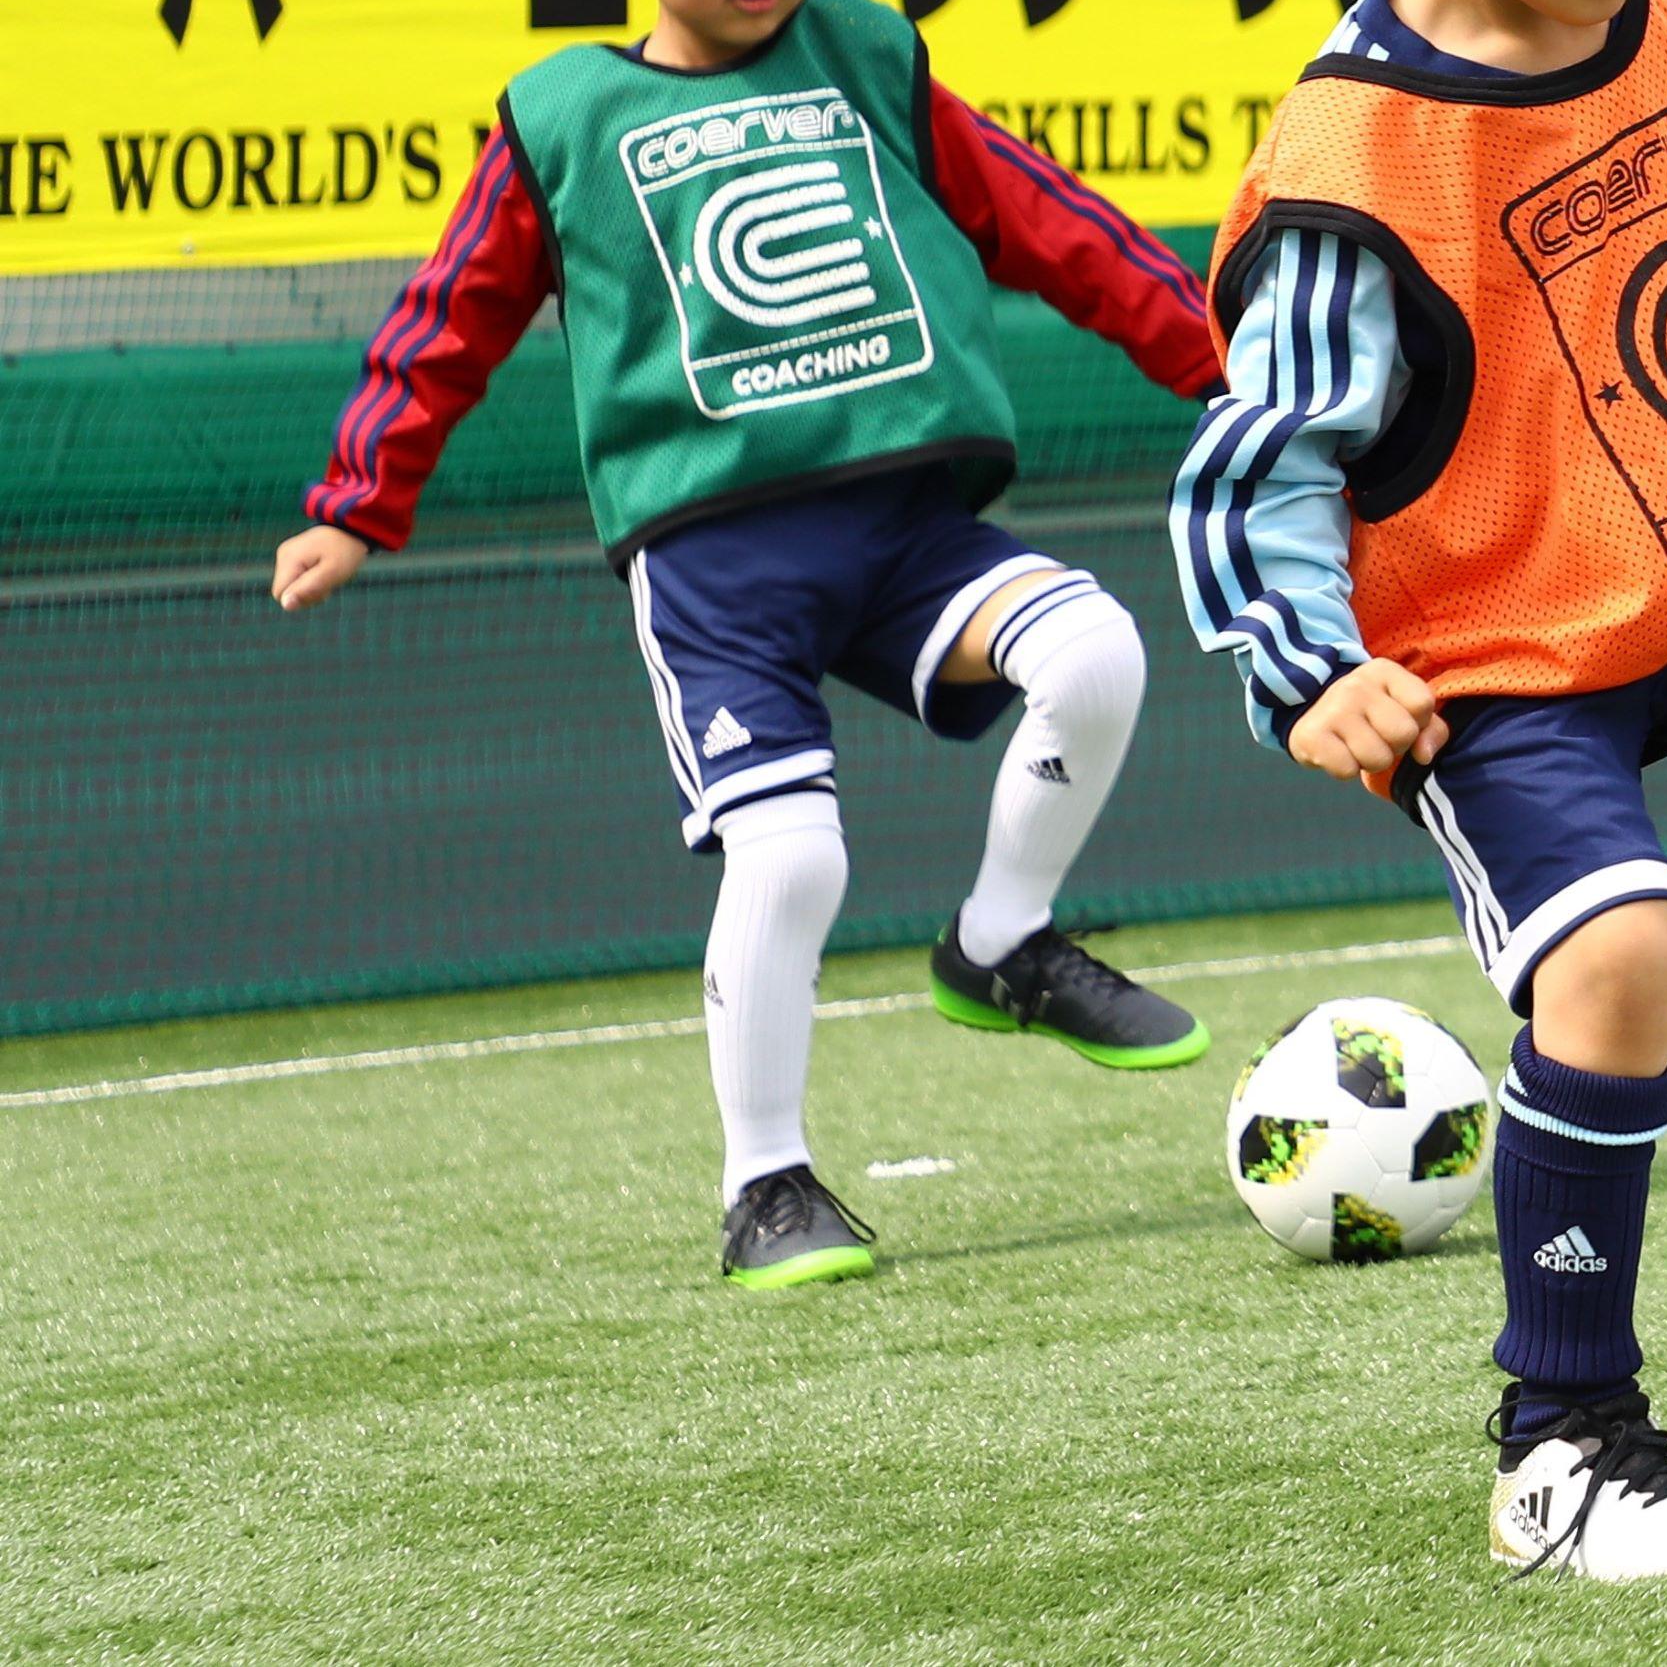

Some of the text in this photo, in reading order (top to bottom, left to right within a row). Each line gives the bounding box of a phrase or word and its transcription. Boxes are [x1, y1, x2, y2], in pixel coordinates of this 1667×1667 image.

[101, 122, 441, 213] WORLD'S
[637, 100, 856, 179] coerver
[731, 334, 891, 396] COACHING
[1533, 1249, 1608, 1273] adidas
